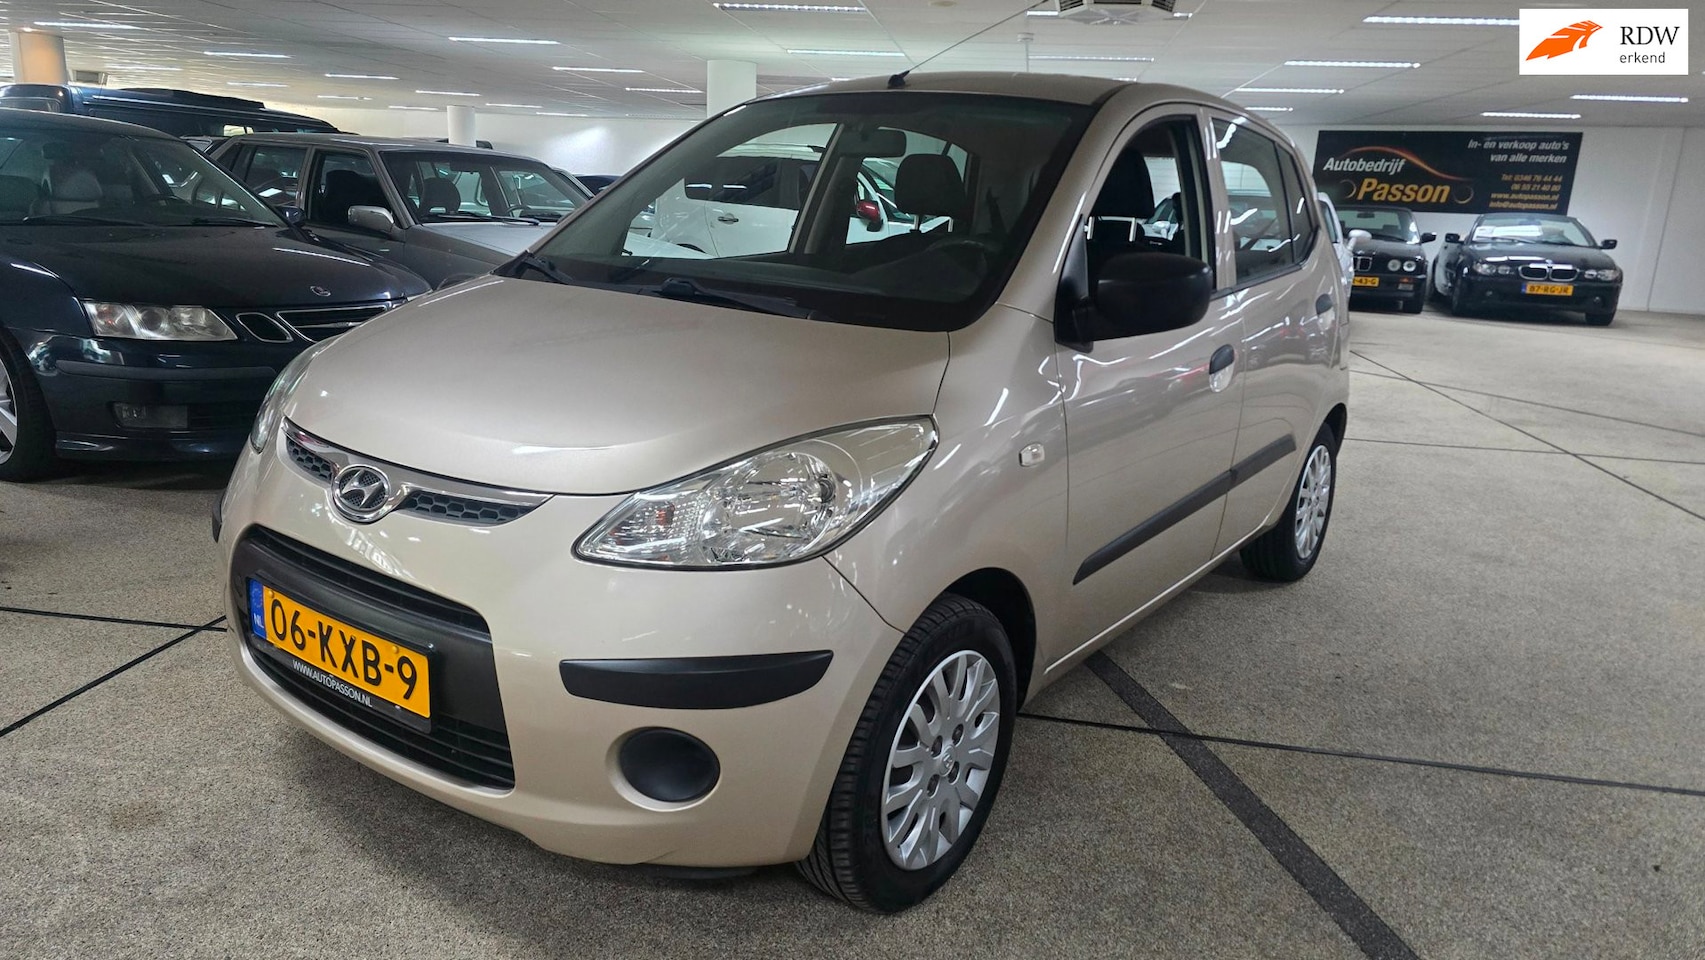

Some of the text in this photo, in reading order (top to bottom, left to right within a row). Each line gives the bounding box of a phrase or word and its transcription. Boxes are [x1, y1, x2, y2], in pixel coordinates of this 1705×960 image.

[1467, 139, 1482, 149] In-
[1498, 140, 1537, 151] verkoop
[1538, 140, 1570, 151] auto's
[1323, 157, 1407, 175] Autobedrijf
[1490, 153, 1568, 163] van alle merken
[1356, 177, 1451, 204] Passon
[253, 614, 264, 629] NL
[270, 598, 418, 701] 06-KXB-9
[292, 659, 373, 708] WWW.AUTOPASSON.NL
